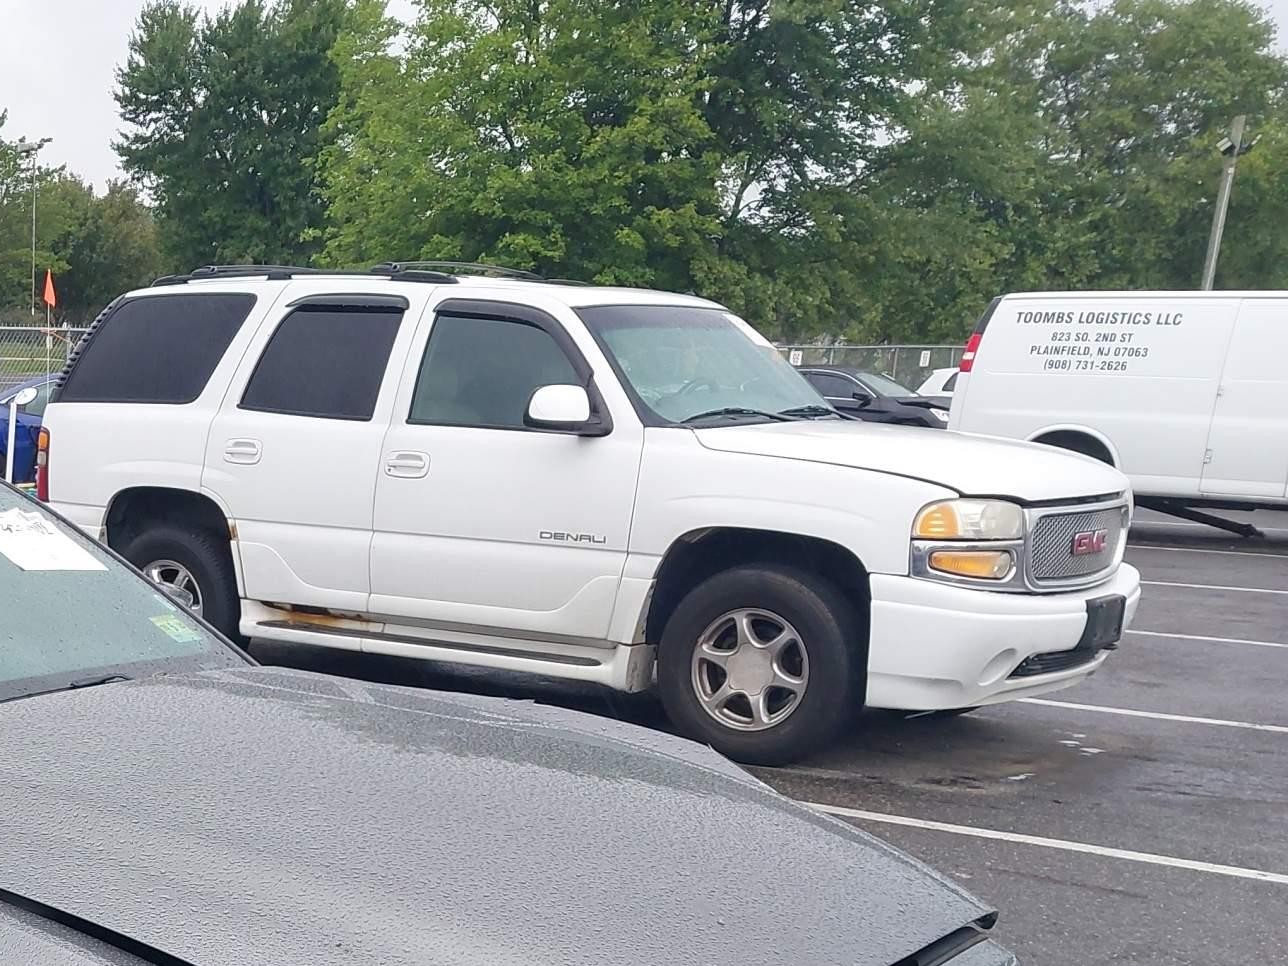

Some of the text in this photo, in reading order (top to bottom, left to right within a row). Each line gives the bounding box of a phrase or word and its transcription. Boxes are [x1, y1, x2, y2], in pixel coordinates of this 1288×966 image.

[1016, 311, 1183, 326] TOOMBS LOGISTICS LLC
[1051, 332, 1134, 343] 823 SO. 2ND ST
[1030, 345, 1148, 357] PLAINFIELD, NJ 07063
[1043, 359, 1127, 371] (908) 731-2626
[539, 531, 606, 544] DENALI
